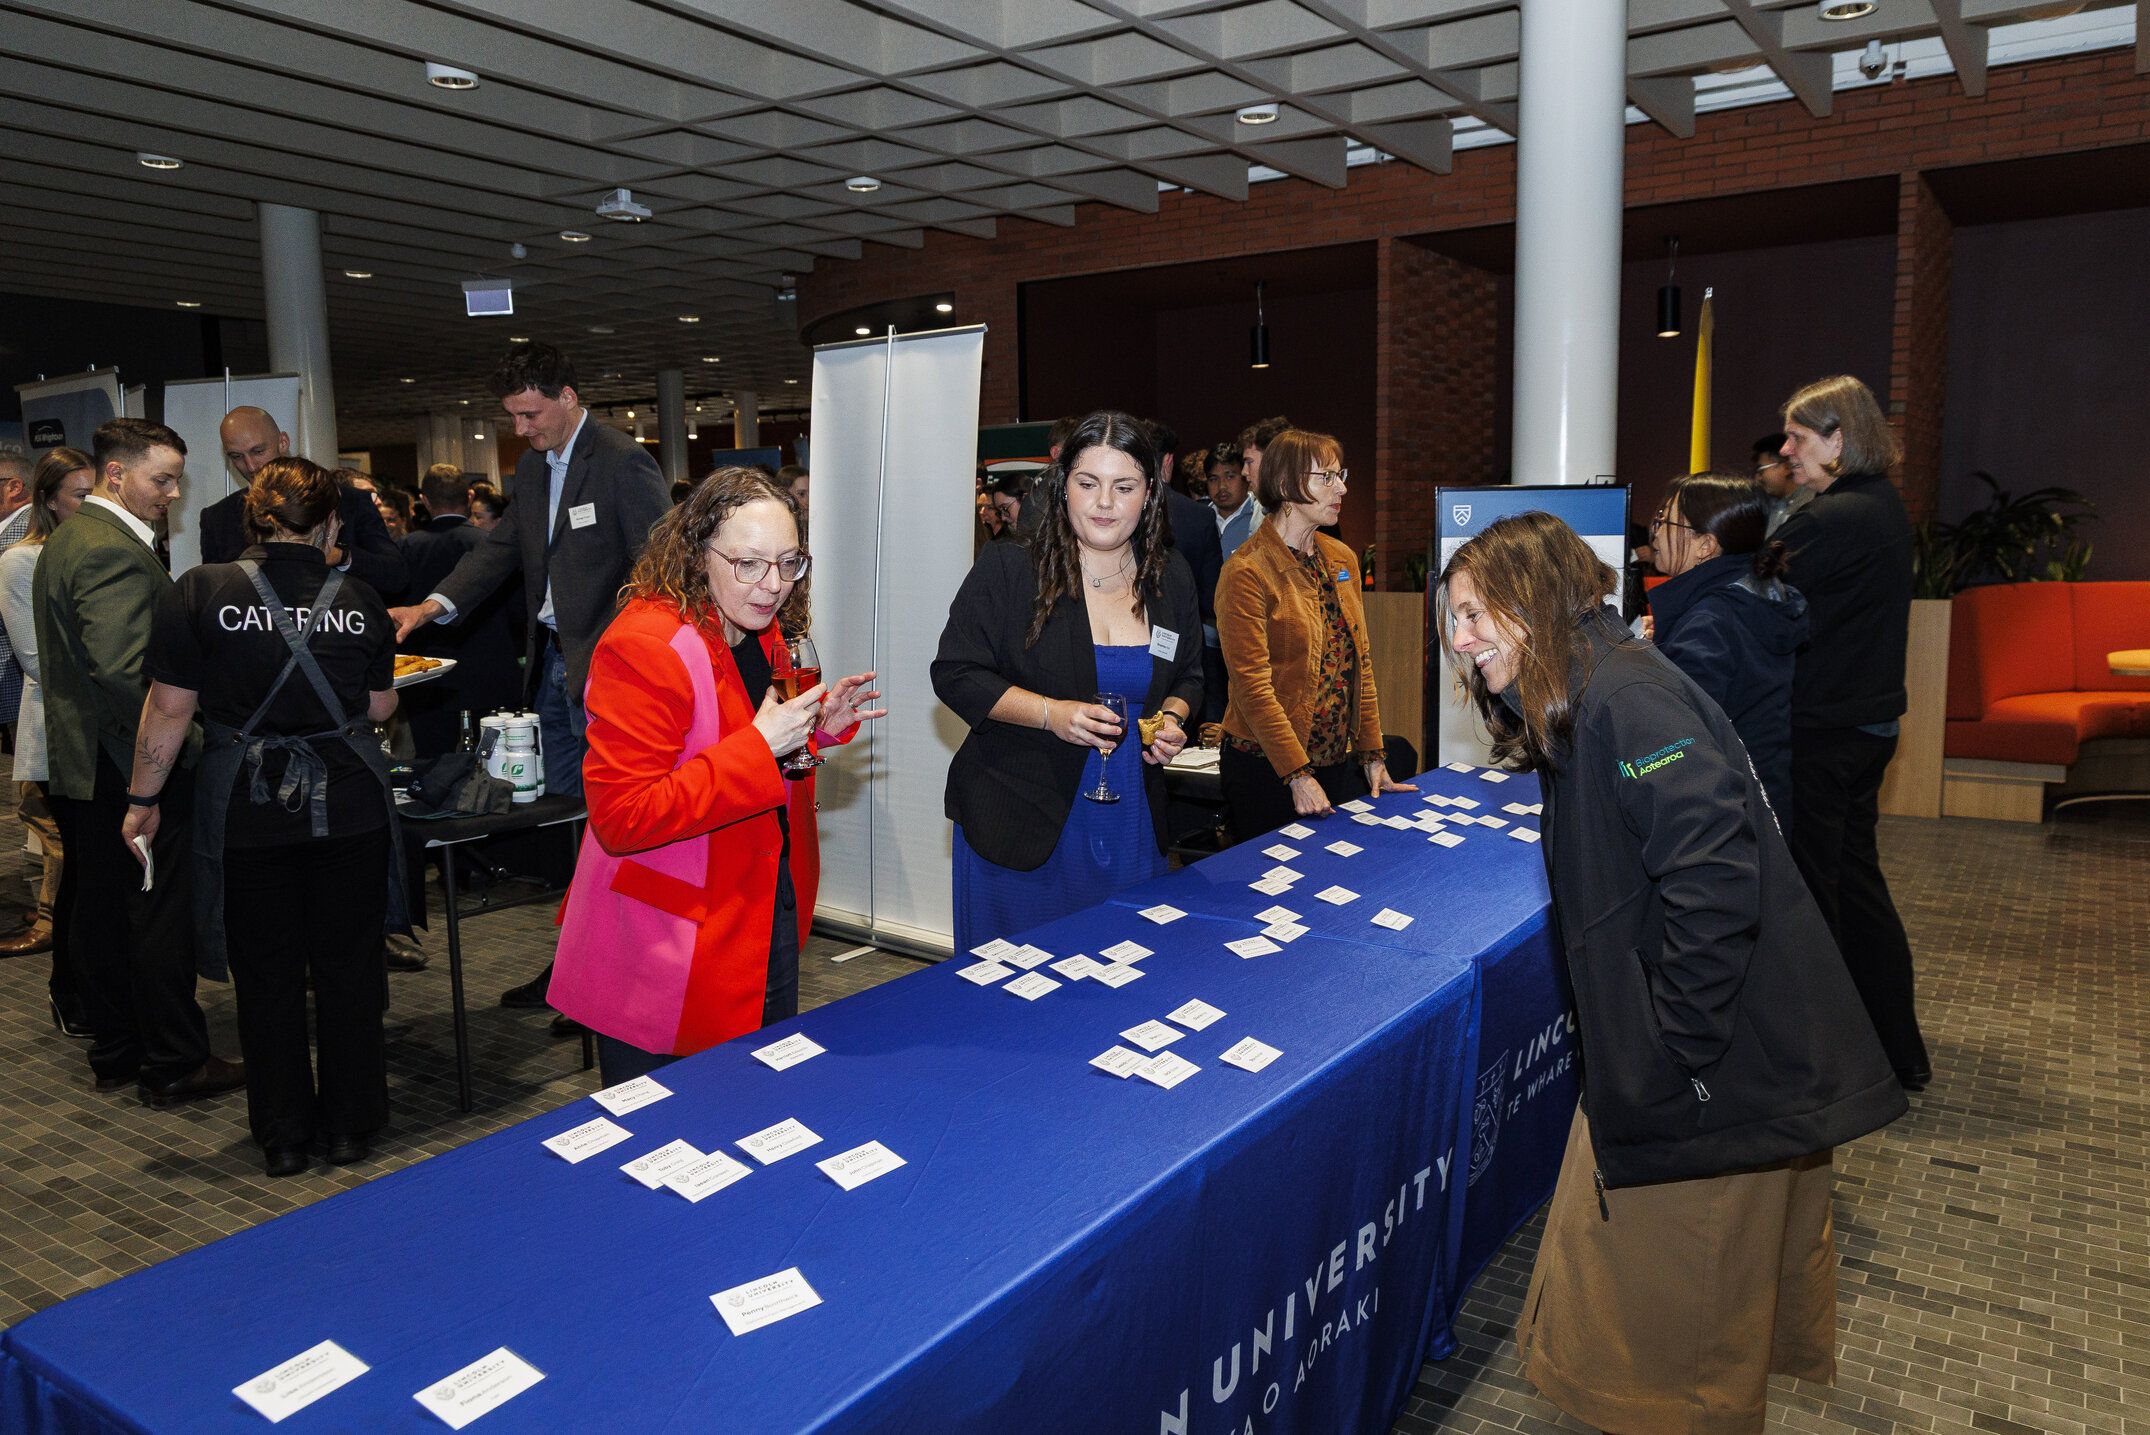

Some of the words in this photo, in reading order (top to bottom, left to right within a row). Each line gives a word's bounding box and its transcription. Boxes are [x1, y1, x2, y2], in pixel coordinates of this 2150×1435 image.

[1635, 737, 1696, 768] Bioprotection
[1640, 751, 1684, 776] Aotearoa
[1513, 1010, 1575, 1081] LINC
[1506, 1093, 1521, 1121] TE
[1527, 1050, 1573, 1101] WHARE
[745, 1281, 778, 1294] LINCOLN
[748, 1279, 794, 1298] UNIVERSITY
[1212, 1146, 1453, 1403] UNIVERSITY
[741, 1305, 766, 1319] Penny
[1263, 1382, 1280, 1414] O
[1294, 1287, 1379, 1393] AORAKI
